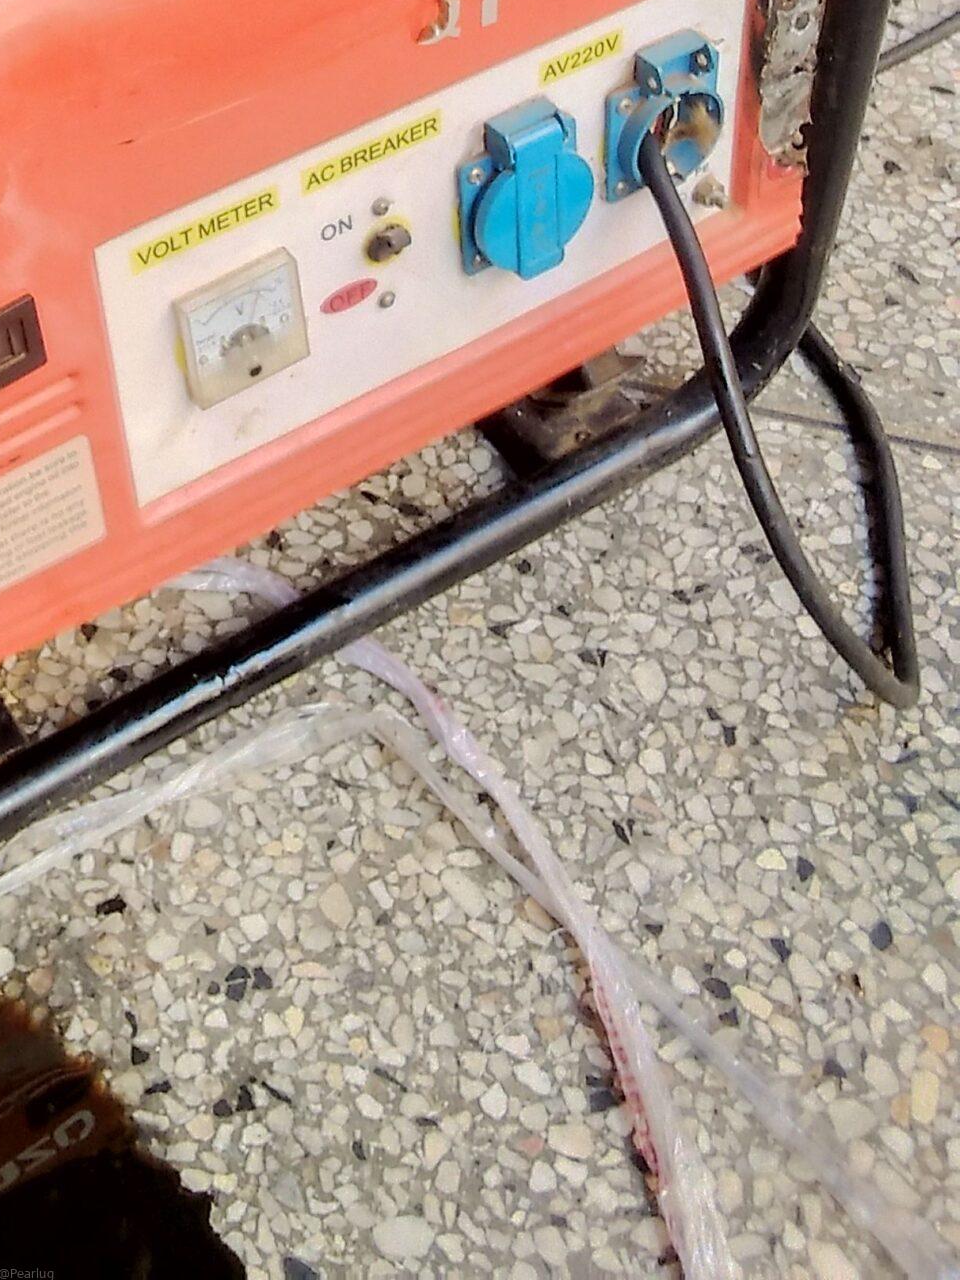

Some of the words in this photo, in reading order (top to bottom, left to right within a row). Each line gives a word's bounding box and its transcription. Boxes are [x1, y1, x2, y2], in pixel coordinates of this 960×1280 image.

[543, 34, 620, 81] AV220V
[305, 163, 336, 191] AC
[340, 116, 439, 174] BREAKER
[136, 227, 193, 266] VOLT
[197, 191, 275, 241] METER
[320, 214, 354, 242] ON
[329, 279, 375, 313] OFF
